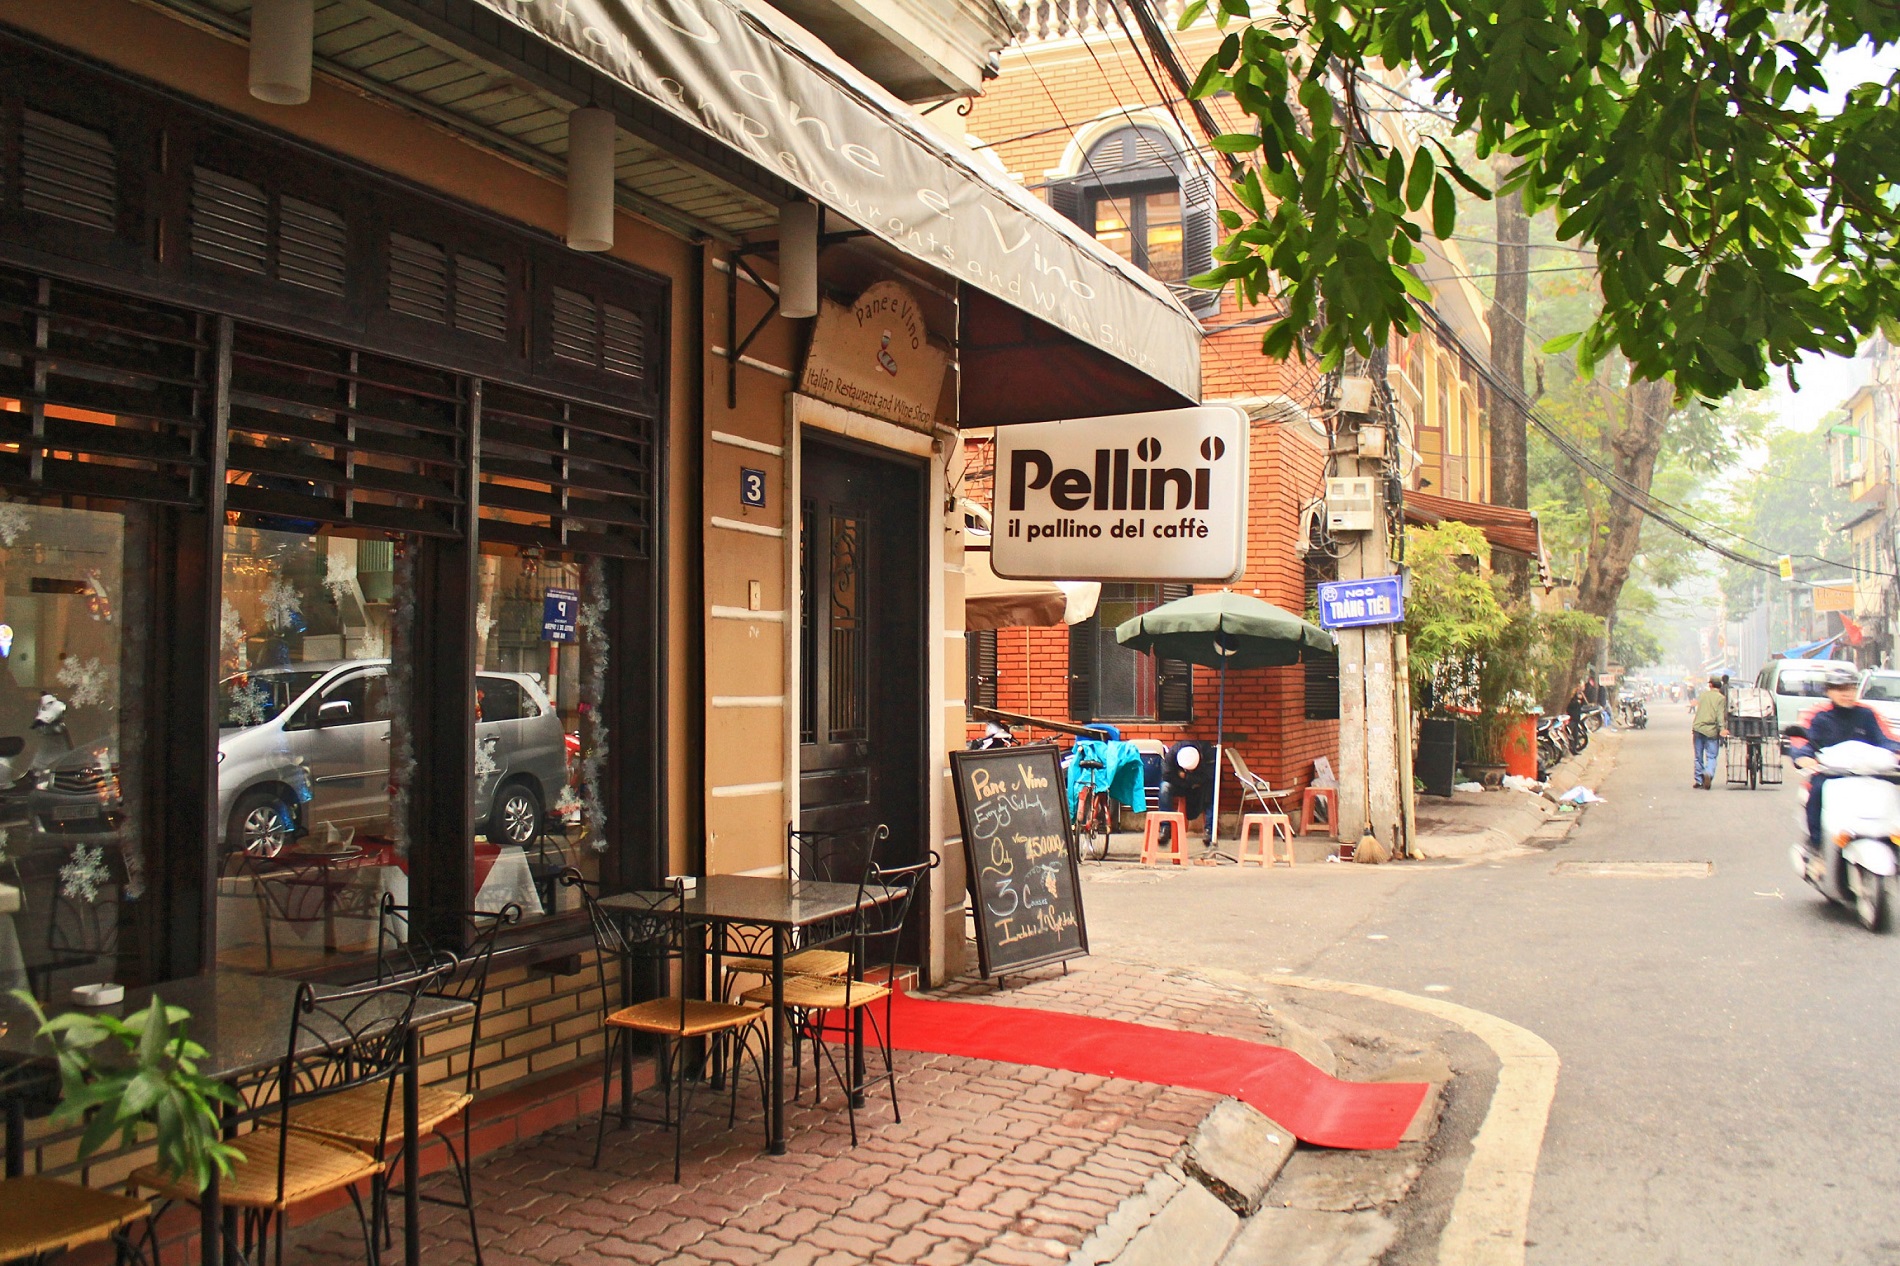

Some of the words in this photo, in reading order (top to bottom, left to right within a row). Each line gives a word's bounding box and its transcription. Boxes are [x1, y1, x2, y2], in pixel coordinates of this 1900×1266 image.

[515, 0, 722, 130] talian
[967, 260, 1022, 296] and
[1100, 323, 1156, 369] Shops
[917, 188, 955, 220] e
[980, 204, 1096, 300] Vino
[855, 296, 888, 328] Pane
[890, 298, 899, 313] e
[901, 301, 919, 350] Vino
[806, 368, 834, 392] Italian
[835, 377, 878, 406] Restaurant
[878, 394, 893, 412] and
[893, 397, 914, 418] Wine
[912, 403, 931, 424] Shop
[746, 474, 762, 502] 3
[1009, 436, 1225, 511] Pellini
[1008, 519, 1020, 538] il
[1027, 518, 1103, 542] pallino
[1110, 518, 1145, 539] del
[1153, 517, 1209, 539] caffè
[971, 768, 1006, 801] Pane
[1018, 763, 1049, 792] Vino
[987, 878, 1018, 917] 3
